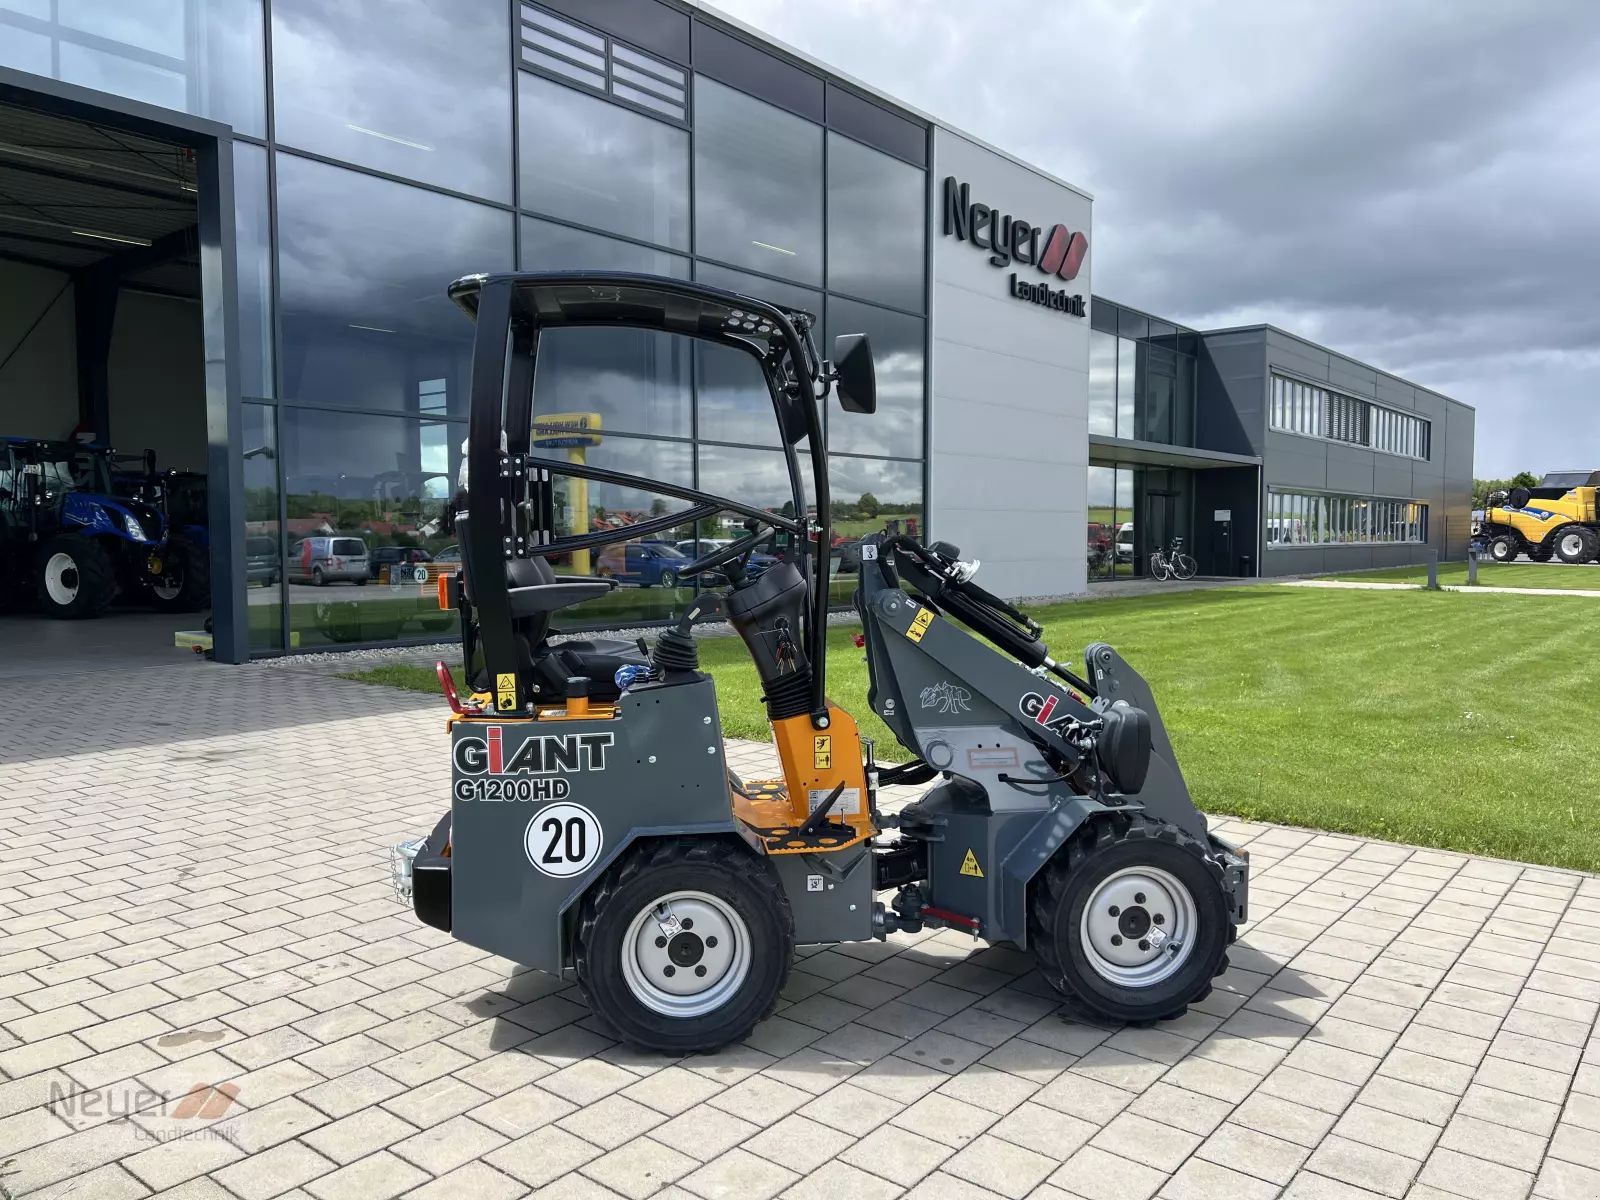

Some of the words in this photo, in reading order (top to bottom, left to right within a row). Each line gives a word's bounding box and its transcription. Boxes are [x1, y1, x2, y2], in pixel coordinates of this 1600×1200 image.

[944, 176, 1042, 267] Neyer
[1010, 273, 1086, 318] Landtechnik
[455, 778, 570, 801] G1200HD
[541, 817, 586, 863] 20
